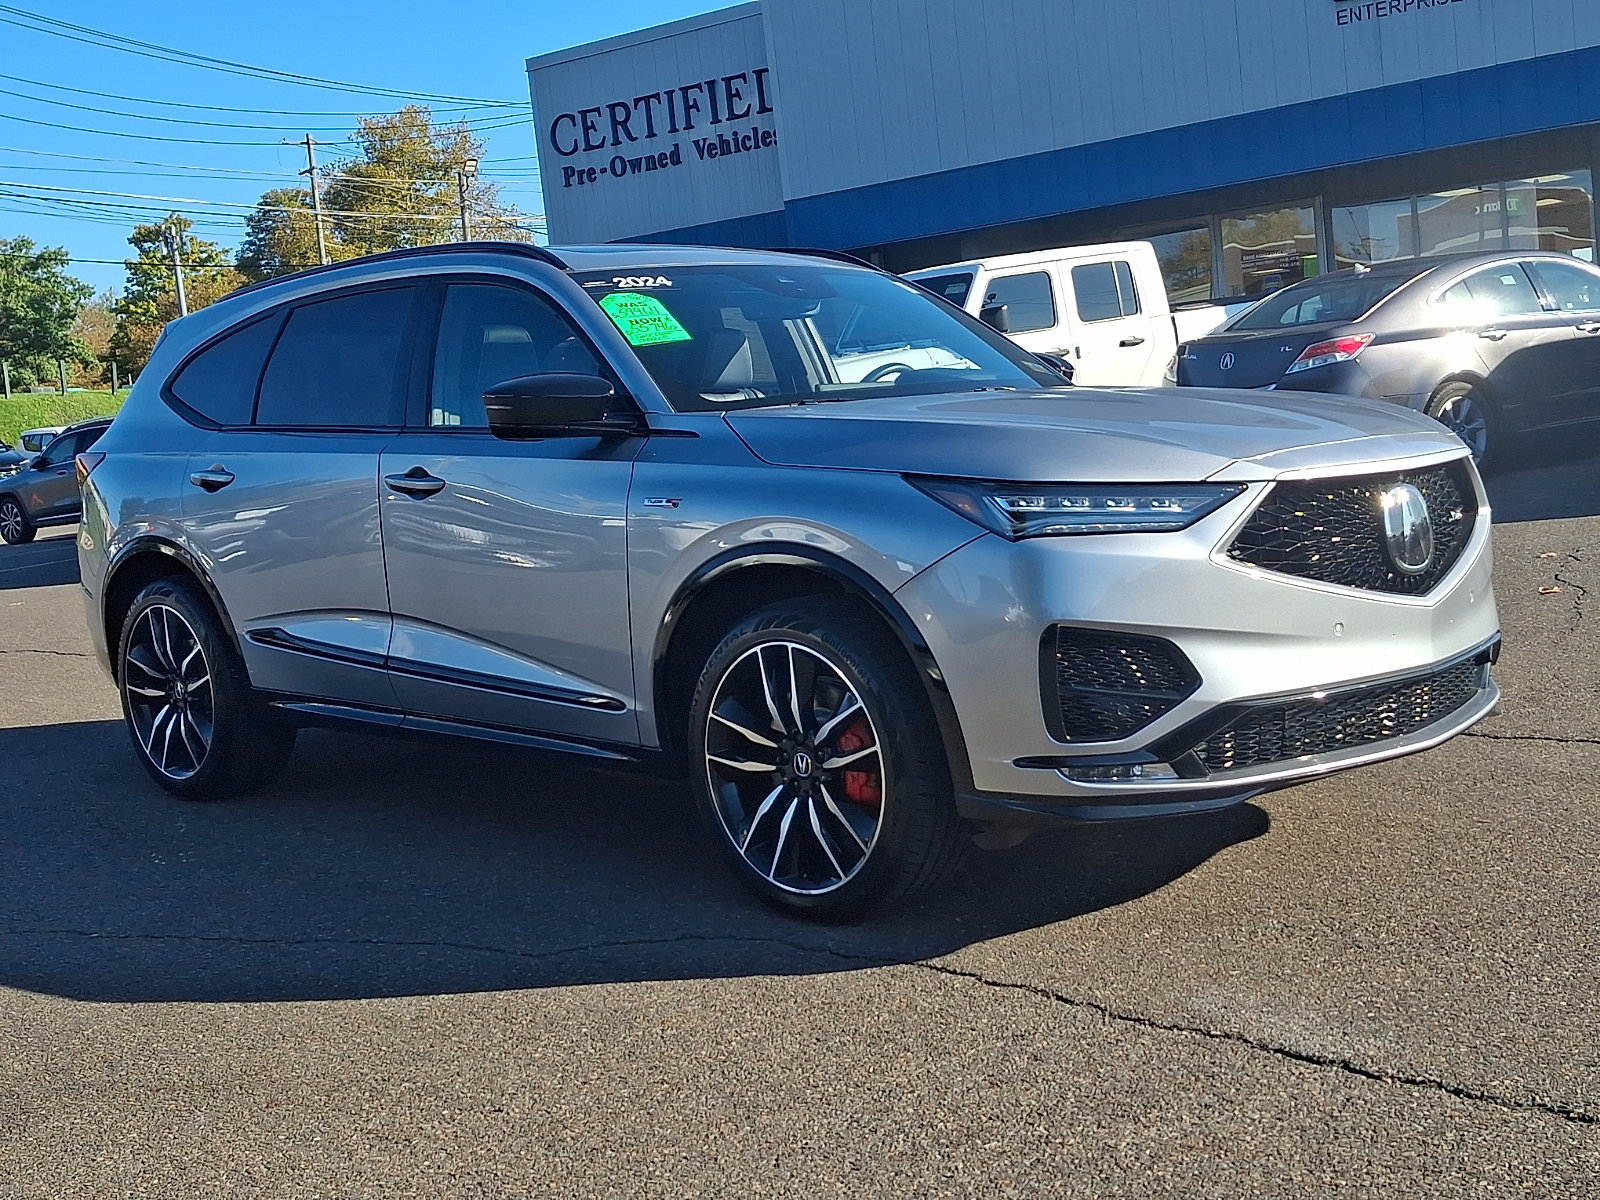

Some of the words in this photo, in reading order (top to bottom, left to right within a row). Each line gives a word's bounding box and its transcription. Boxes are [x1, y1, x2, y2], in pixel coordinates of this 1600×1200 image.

[1336, 0, 1463, 26] ENTERPR
[562, 144, 683, 188] Pre-Owned
[612, 276, 673, 288] 2024
[628, 317, 662, 326] NOW
